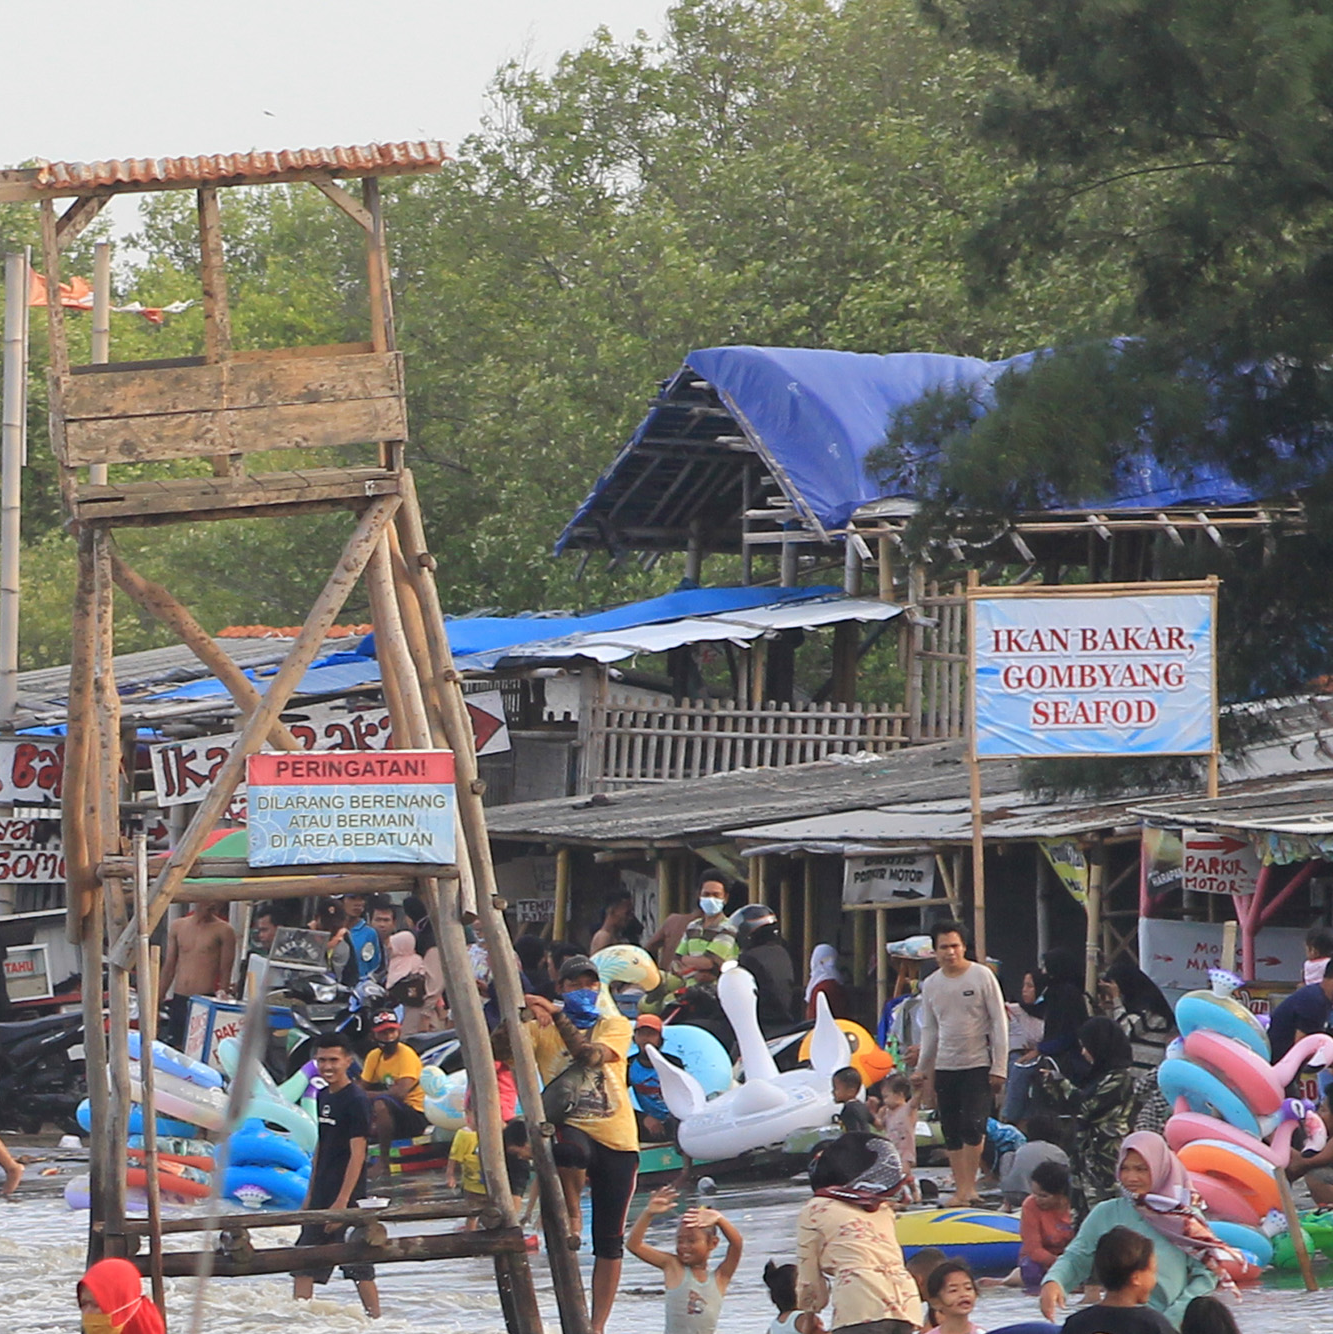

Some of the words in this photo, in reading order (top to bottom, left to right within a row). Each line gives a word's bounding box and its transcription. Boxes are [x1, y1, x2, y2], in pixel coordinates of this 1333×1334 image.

[992, 629, 1071, 653] IKAN
[1079, 626, 1195, 654] BAKAR,
[1002, 663, 1185, 690] GOMBYANG
[1032, 700, 1157, 727] SEAFOD
[276, 759, 427, 778] PERINGATAN!
[257, 795, 344, 810] DILARANG
[350, 794, 446, 809] BERENANG
[288, 814, 332, 829] ATAU
[337, 813, 414, 828] BERMAIN
[271, 834, 287, 848] DI
[292, 833, 339, 848] AREA
[343, 832, 433, 847] BEBATUAN
[1185, 855, 1247, 875] PARKIR
[890, 868, 924, 883] MOTOR
[1184, 877, 1241, 894] MOTOR
[4, 961, 35, 974] TAHU
